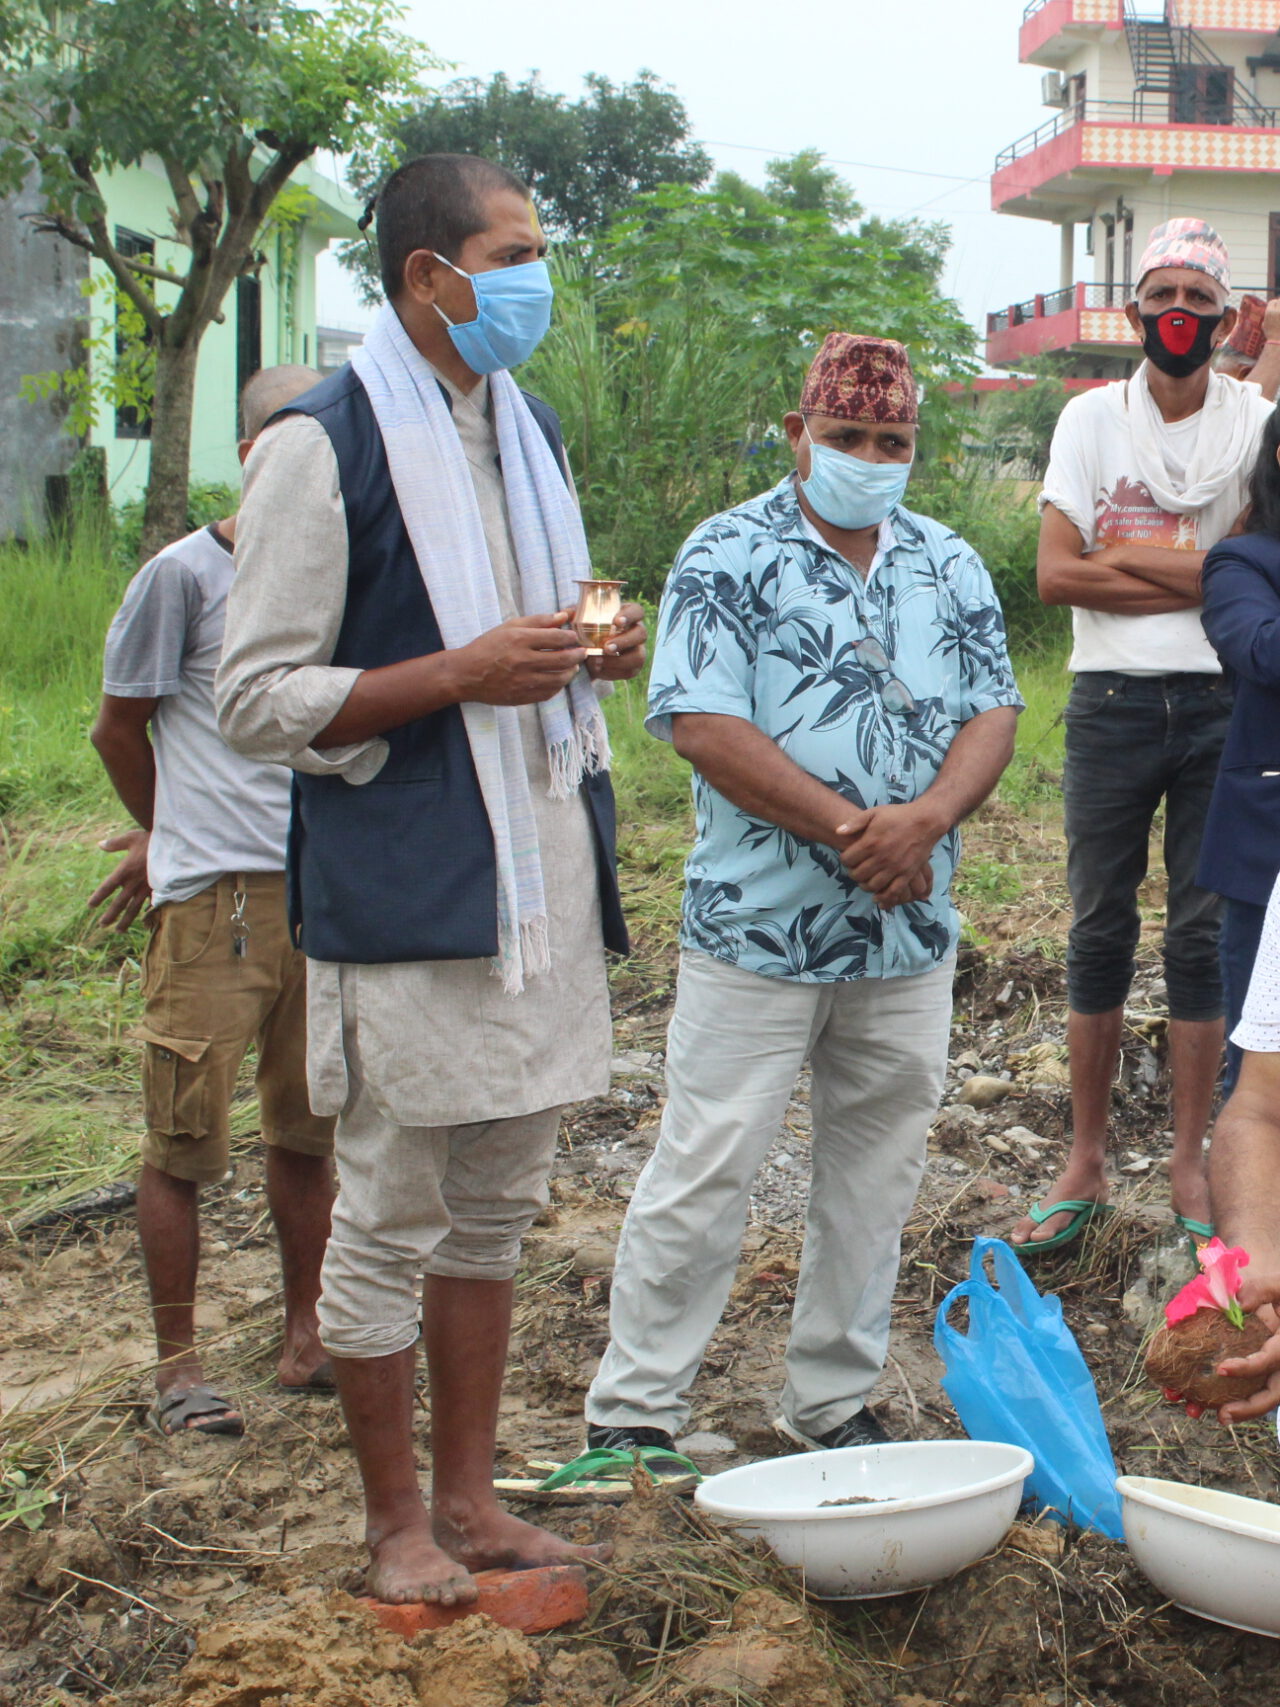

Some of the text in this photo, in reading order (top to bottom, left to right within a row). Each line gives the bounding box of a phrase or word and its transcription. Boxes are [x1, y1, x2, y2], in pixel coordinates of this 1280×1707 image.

[1110, 503, 1121, 515] My
[1115, 516, 1132, 527] safer
[1134, 516, 1165, 527] because
[1121, 529, 1135, 539] said
[1137, 529, 1152, 539] NO!
